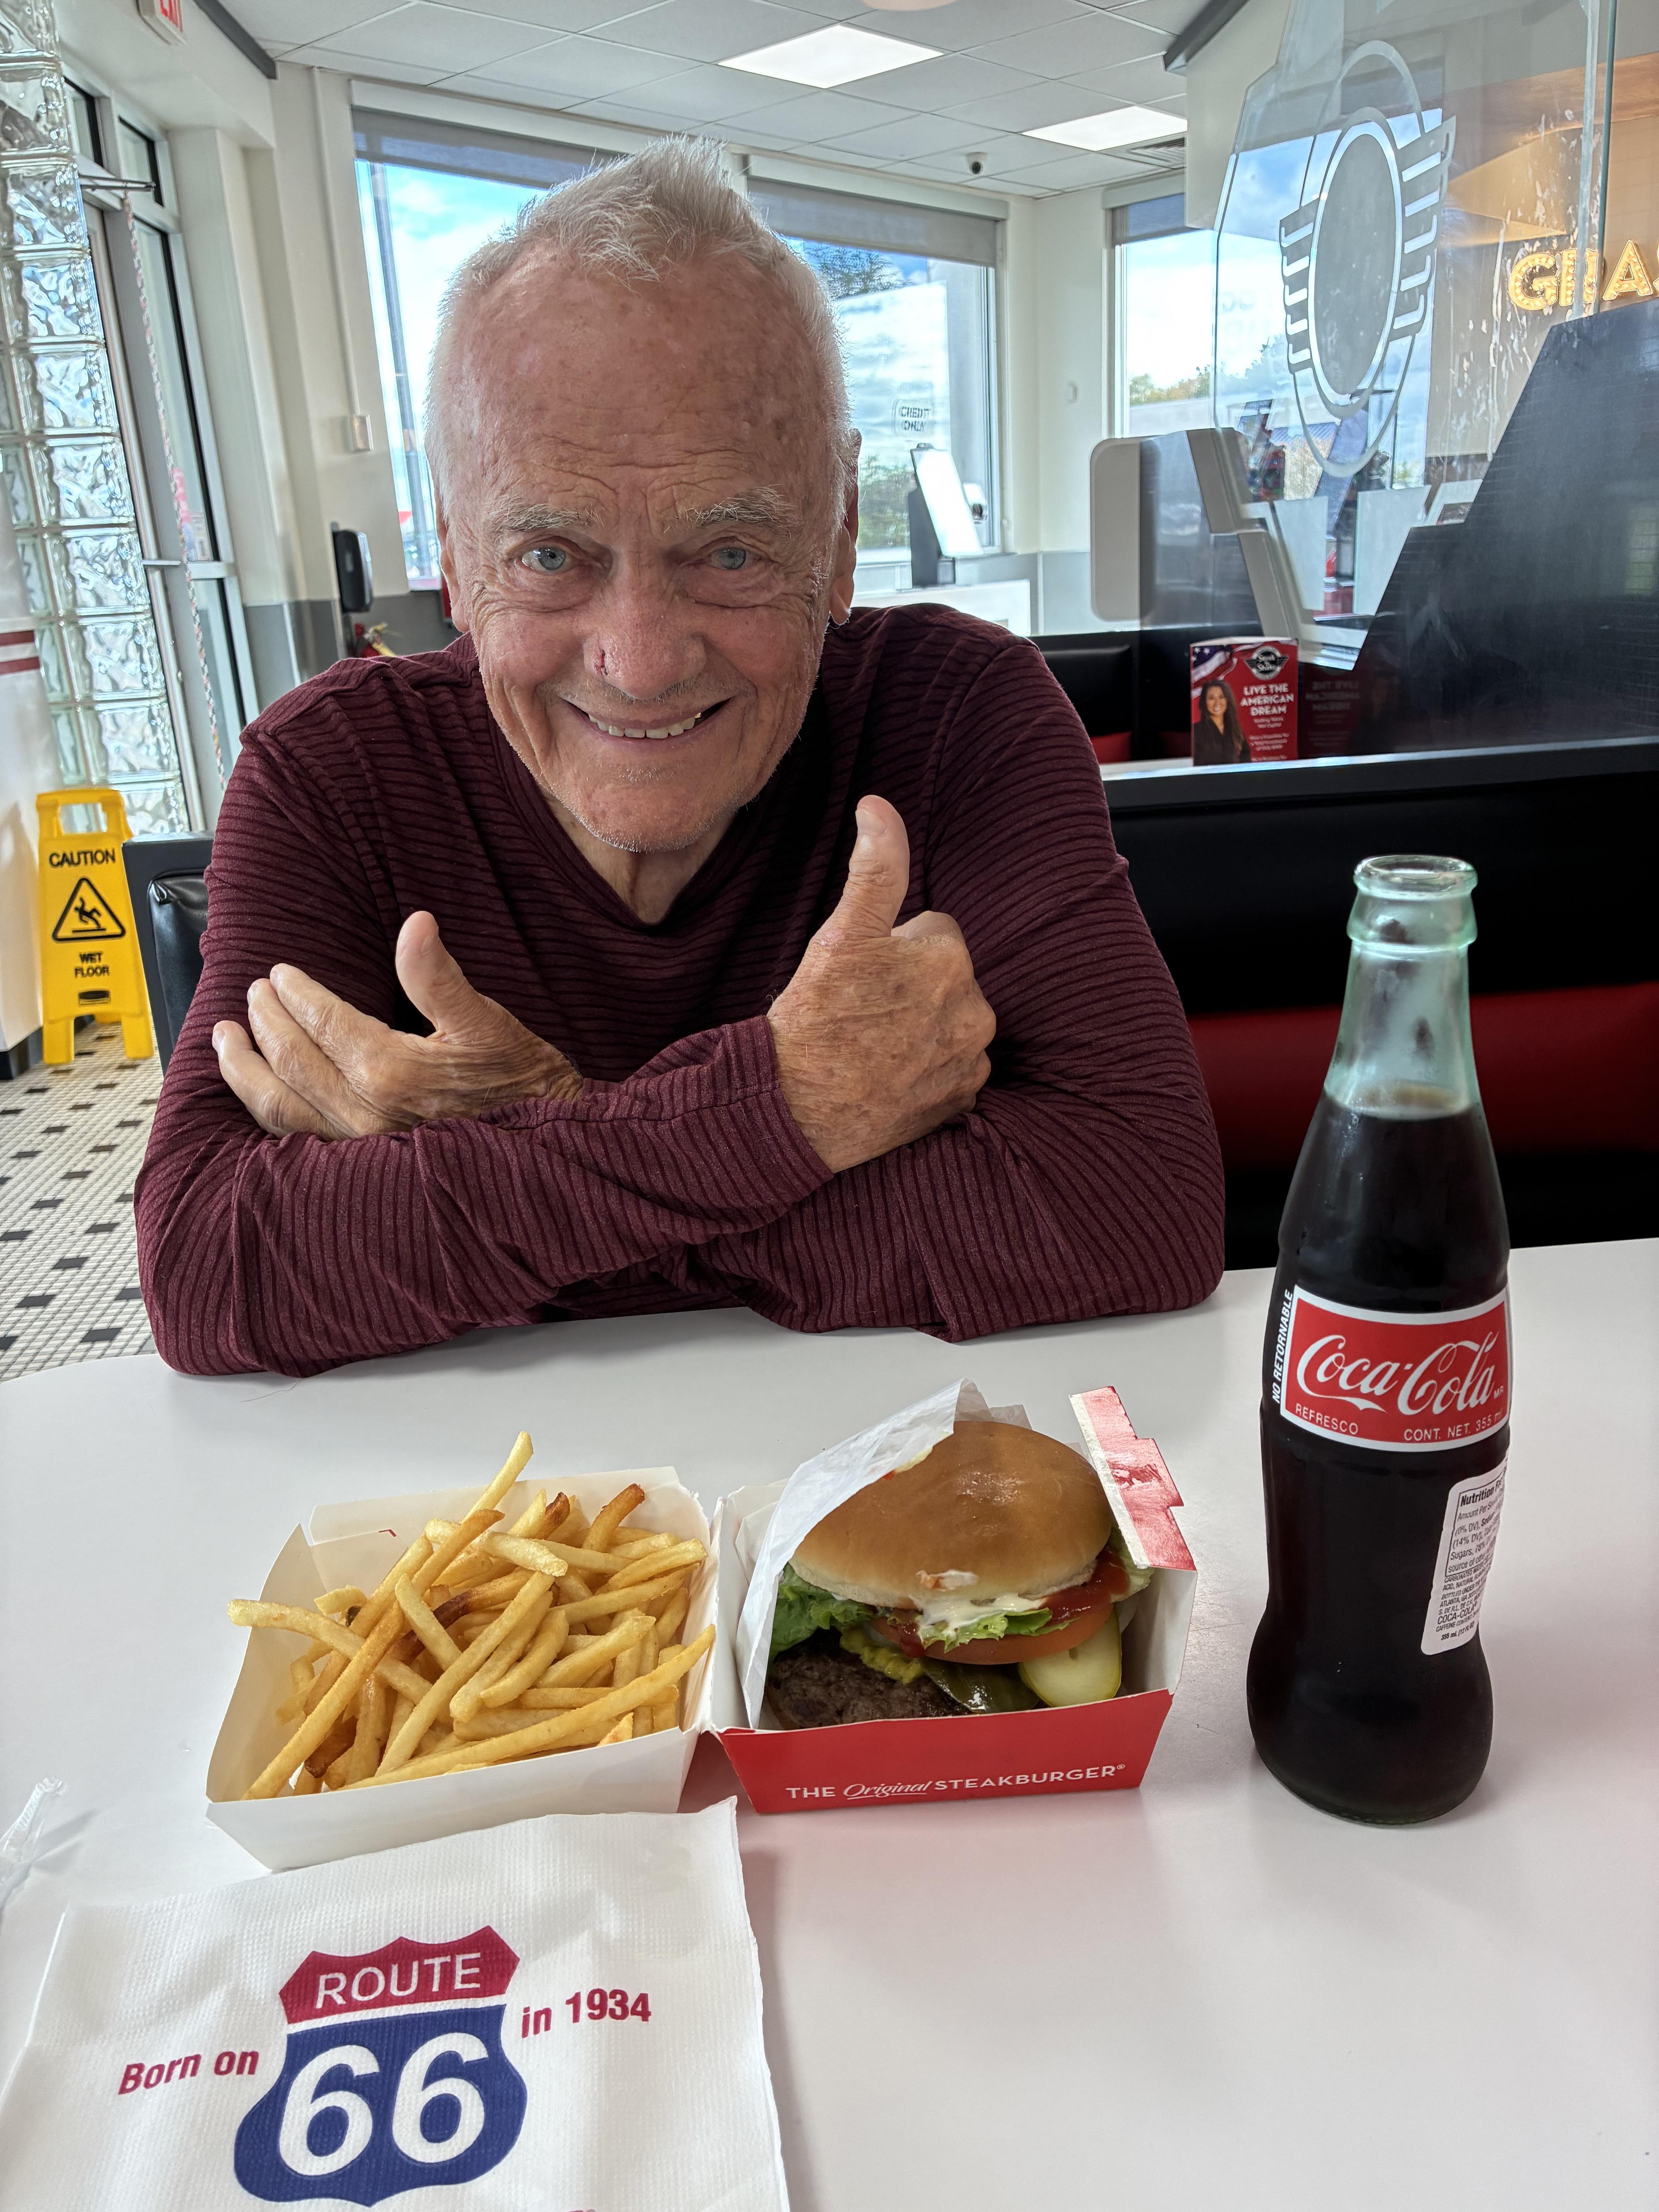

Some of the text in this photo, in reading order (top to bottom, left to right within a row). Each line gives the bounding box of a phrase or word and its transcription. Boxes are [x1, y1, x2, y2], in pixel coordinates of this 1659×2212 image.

[899, 406, 932, 419] CREDIT
[902, 420, 926, 432] ONLY
[1243, 683, 1289, 696] LIVE THE
[1241, 694, 1294, 707] AMERICAN
[1250, 705, 1287, 716] DREAM
[49, 848, 115, 867] CAUTION
[79, 951, 103, 964] WET
[74, 964, 110, 978] FLOOR
[1273, 1289, 1293, 1404] NO RETORNABLE
[1297, 1331, 1499, 1416] Coca-Cola
[1295, 1403, 1358, 1435] REFRESCO
[1404, 1428, 1441, 1441] CONT.
[1447, 1422, 1471, 1438] NET.
[1476, 1415, 1492, 1431] 355
[1460, 1486, 1495, 1507] Nutrition
[1457, 1508, 1479, 1521] Amount
[1453, 1536, 1469, 1549] (14%
[1450, 1549, 1474, 1560] Sugars,
[1448, 1562, 1468, 1573] source
[786, 1787, 836, 1798] THE
[844, 1781, 932, 1800] Original
[316, 1953, 481, 2009] ROUTE
[521, 1988, 651, 2039] in 1934
[119, 2051, 259, 2095] Born on
[278, 2032, 489, 2176] 66
